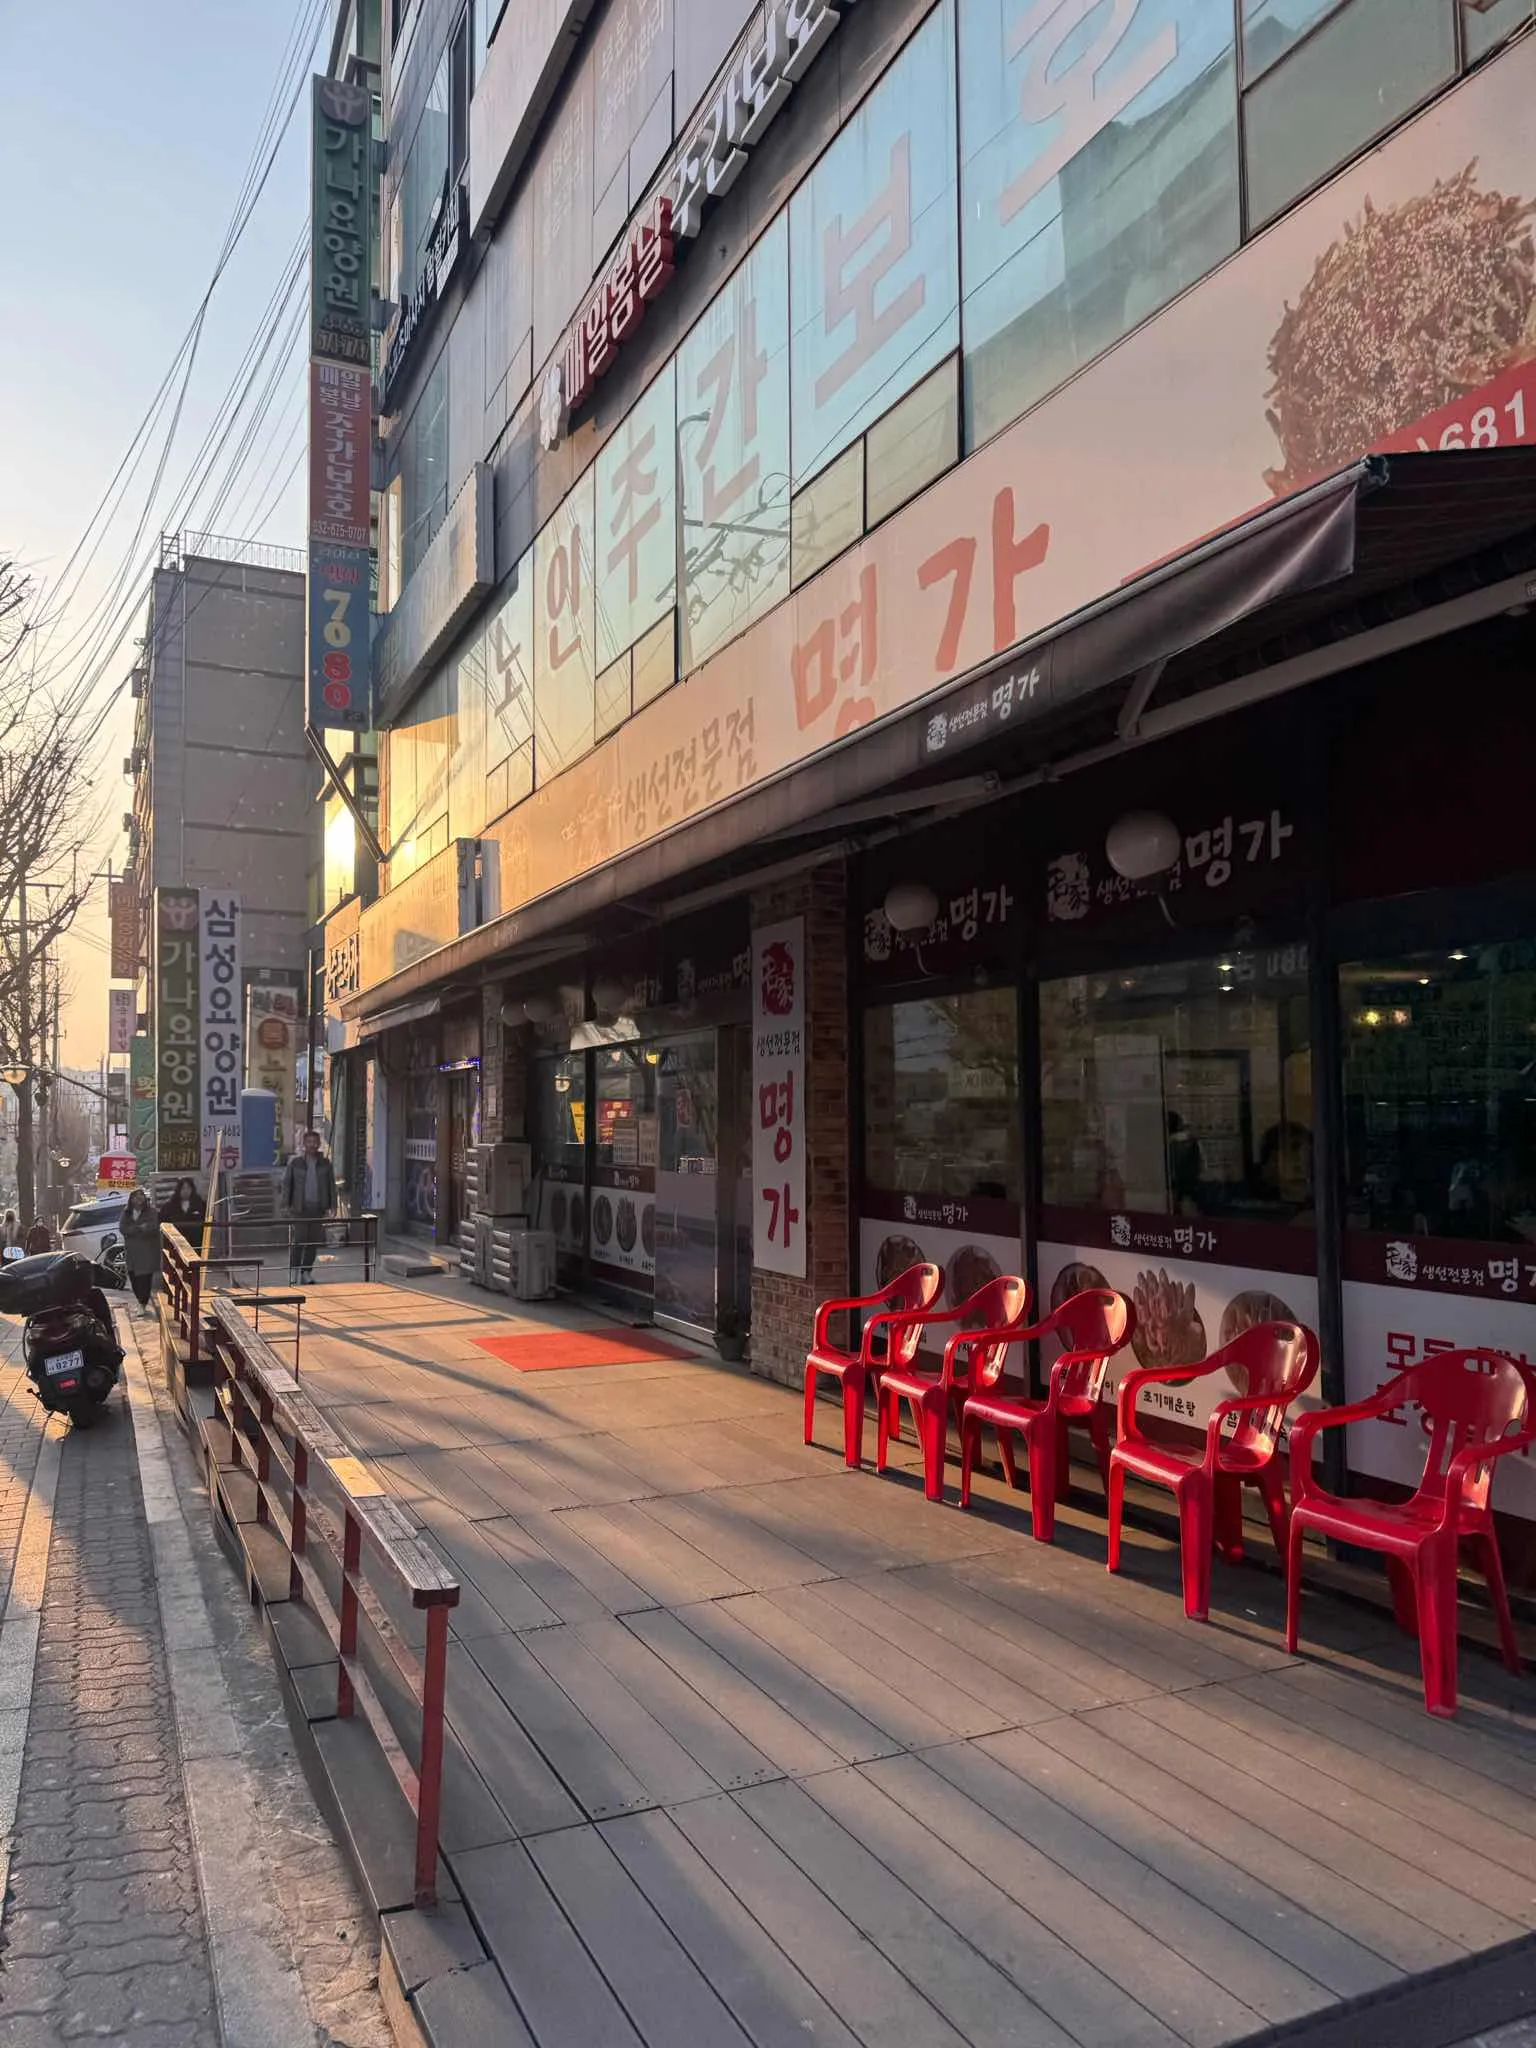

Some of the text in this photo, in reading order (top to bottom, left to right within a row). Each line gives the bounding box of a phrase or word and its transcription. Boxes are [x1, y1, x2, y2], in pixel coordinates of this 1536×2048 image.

[324, 127, 363, 310] 가나요양원
[565, 195, 675, 411] 매일봄날
[325, 410, 356, 521] 주간보호
[790, 486, 1050, 740] 명가
[992, 667, 1040, 720] 명가
[623, 696, 758, 838] 생선전문점
[1185, 808, 1294, 888] 명가
[949, 883, 1014, 942] 명가
[160, 941, 197, 1125] 가나요양원
[205, 898, 240, 1117] 삼성요양원
[205, 1144, 240, 1170] 7층
[759, 1069, 799, 1251] 명가
[942, 1202, 968, 1224] 명가
[1133, 1226, 1217, 1255] 생선전문점 명가
[1422, 1264, 1485, 1287] 생선전문점
[1142, 1388, 1197, 1419] 조기매운탕
